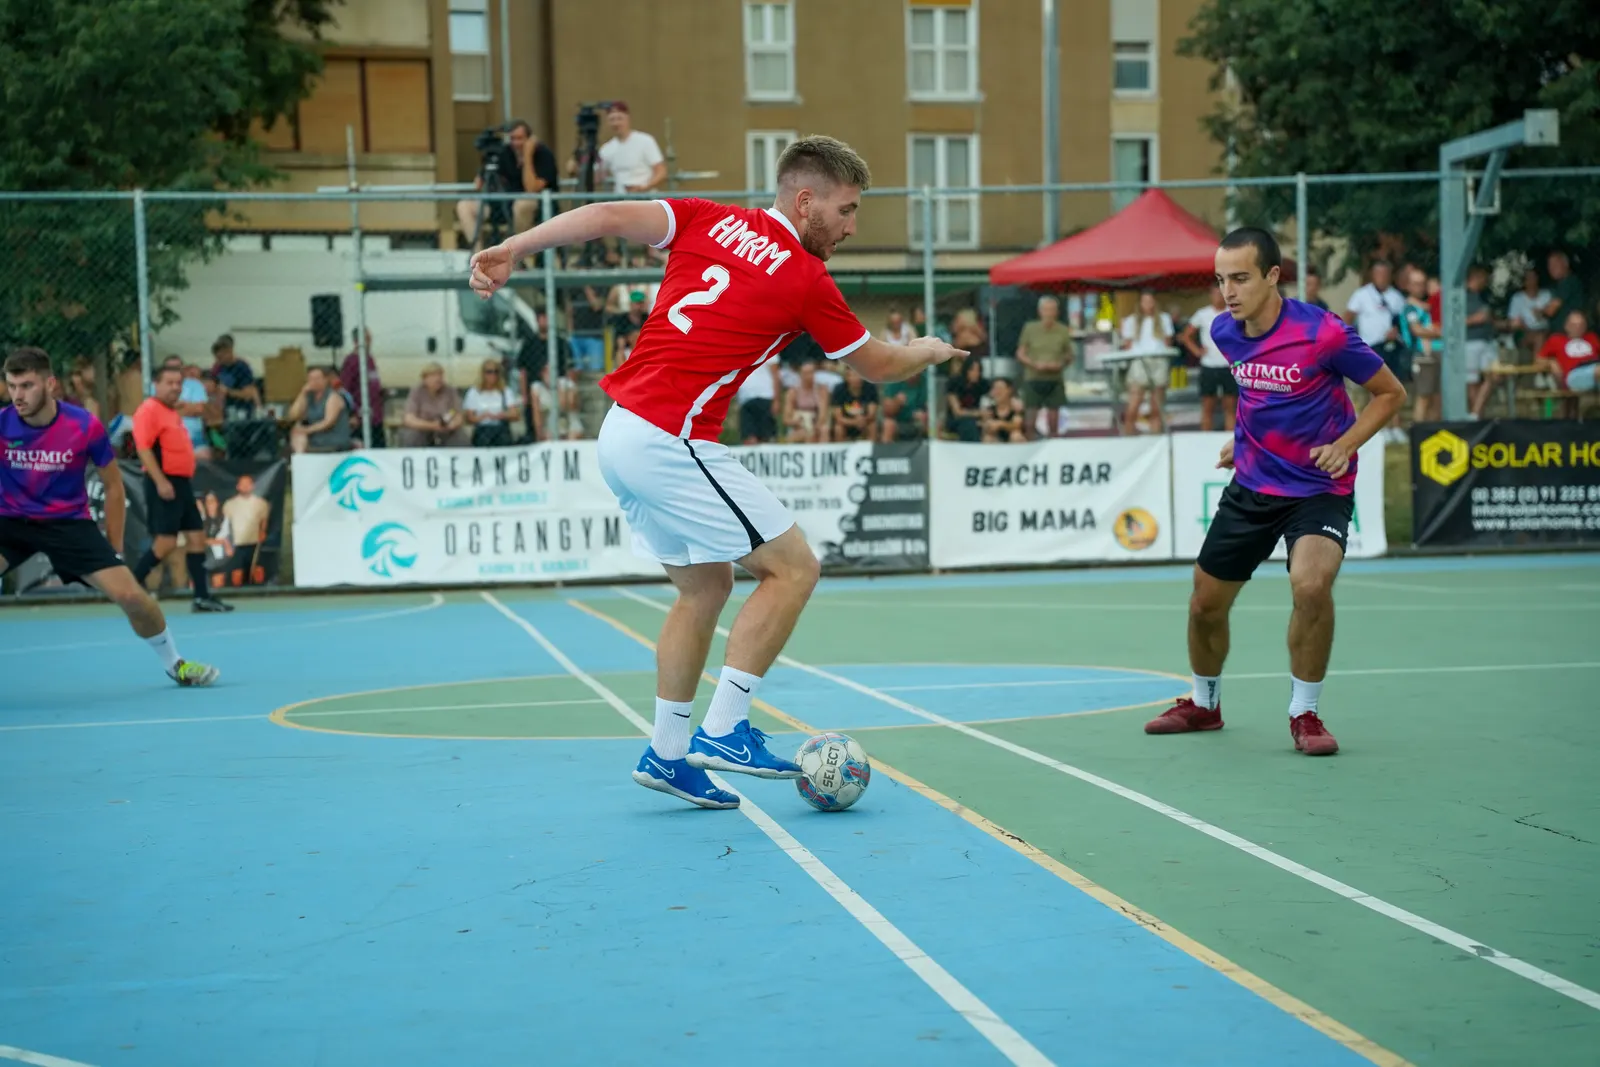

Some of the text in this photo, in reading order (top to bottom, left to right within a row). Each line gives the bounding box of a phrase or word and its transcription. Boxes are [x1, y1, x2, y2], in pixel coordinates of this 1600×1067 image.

[707, 214, 792, 276] HMRM
[667, 264, 731, 335] 2
[5, 448, 74, 464] TRUMIĆ
[402, 449, 581, 491] OCEANGYM
[811, 448, 849, 478] LINE
[1471, 441, 1563, 469] SOLAR
[964, 462, 1113, 488] BEACH BAR
[443, 515, 621, 557] OCEANGYM
[972, 508, 1097, 534] BIG MAMA
[822, 746, 840, 788] SELECT
